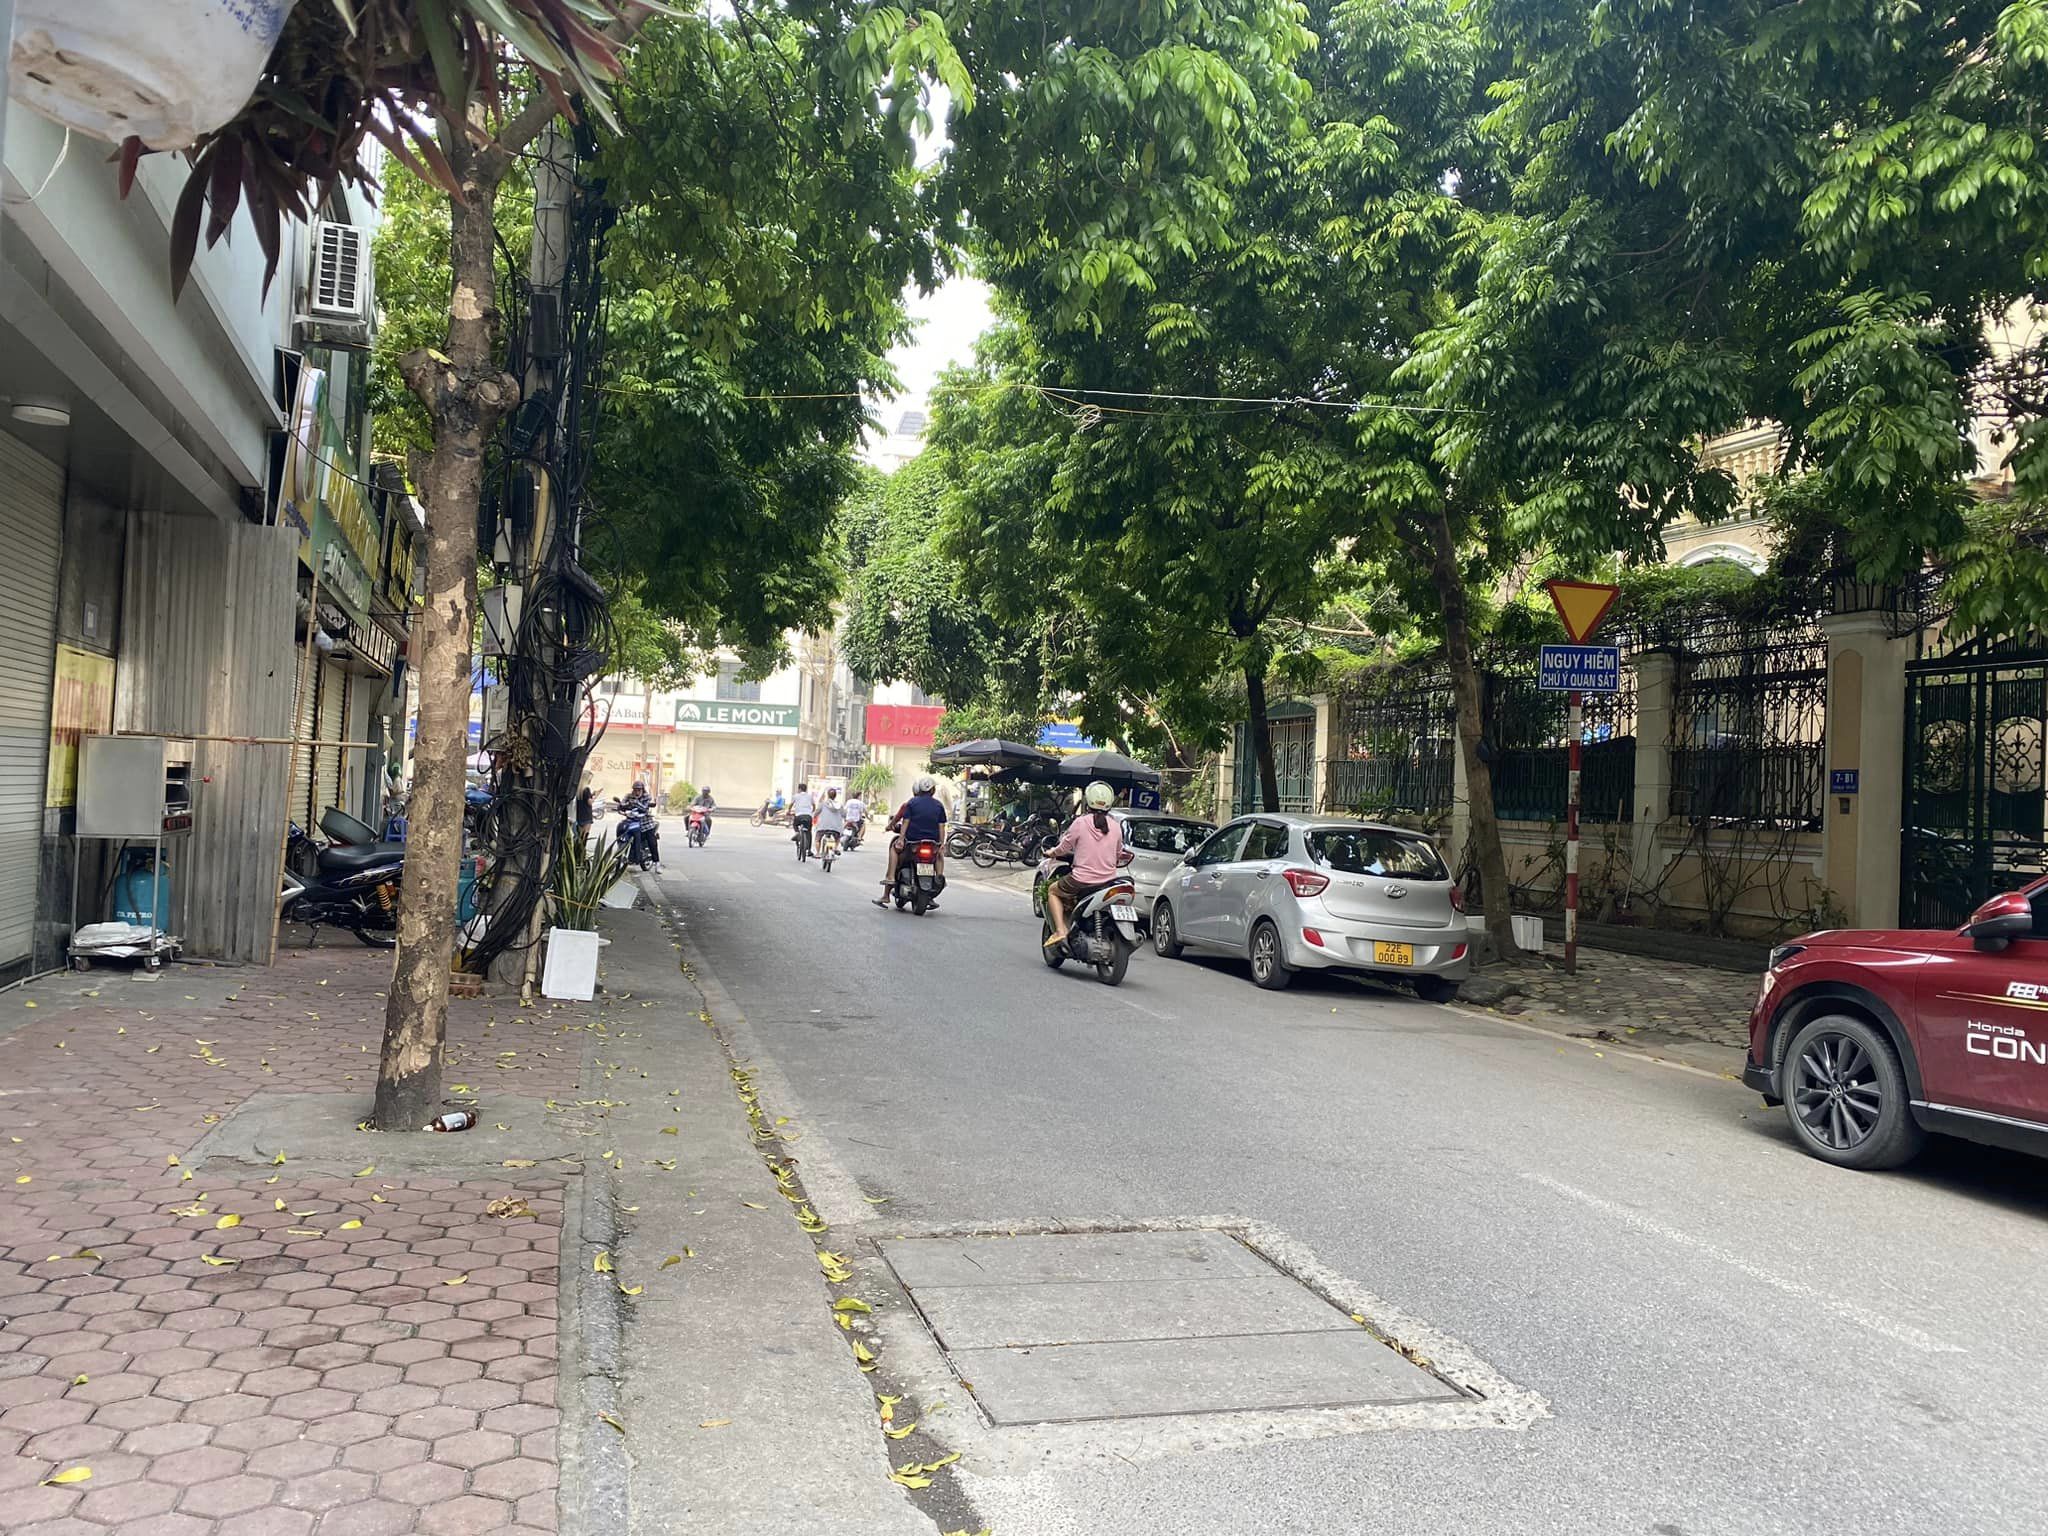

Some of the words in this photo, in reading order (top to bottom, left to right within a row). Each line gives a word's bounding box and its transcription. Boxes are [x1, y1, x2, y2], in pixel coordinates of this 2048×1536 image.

[1544, 653, 1581, 668] NGUY
[1542, 670, 1560, 687] CHÚ
[1562, 671, 1569, 687] Ý
[1570, 673, 1596, 688] QUAN
[1597, 671, 1615, 688] SÁT
[706, 706, 729, 722] LE
[731, 708, 788, 725] MONT
[1385, 943, 1402, 954] 22E
[2006, 981, 2040, 1000] FEEL
[1967, 1019, 2026, 1038] Honda
[1966, 1032, 2047, 1065] CON
